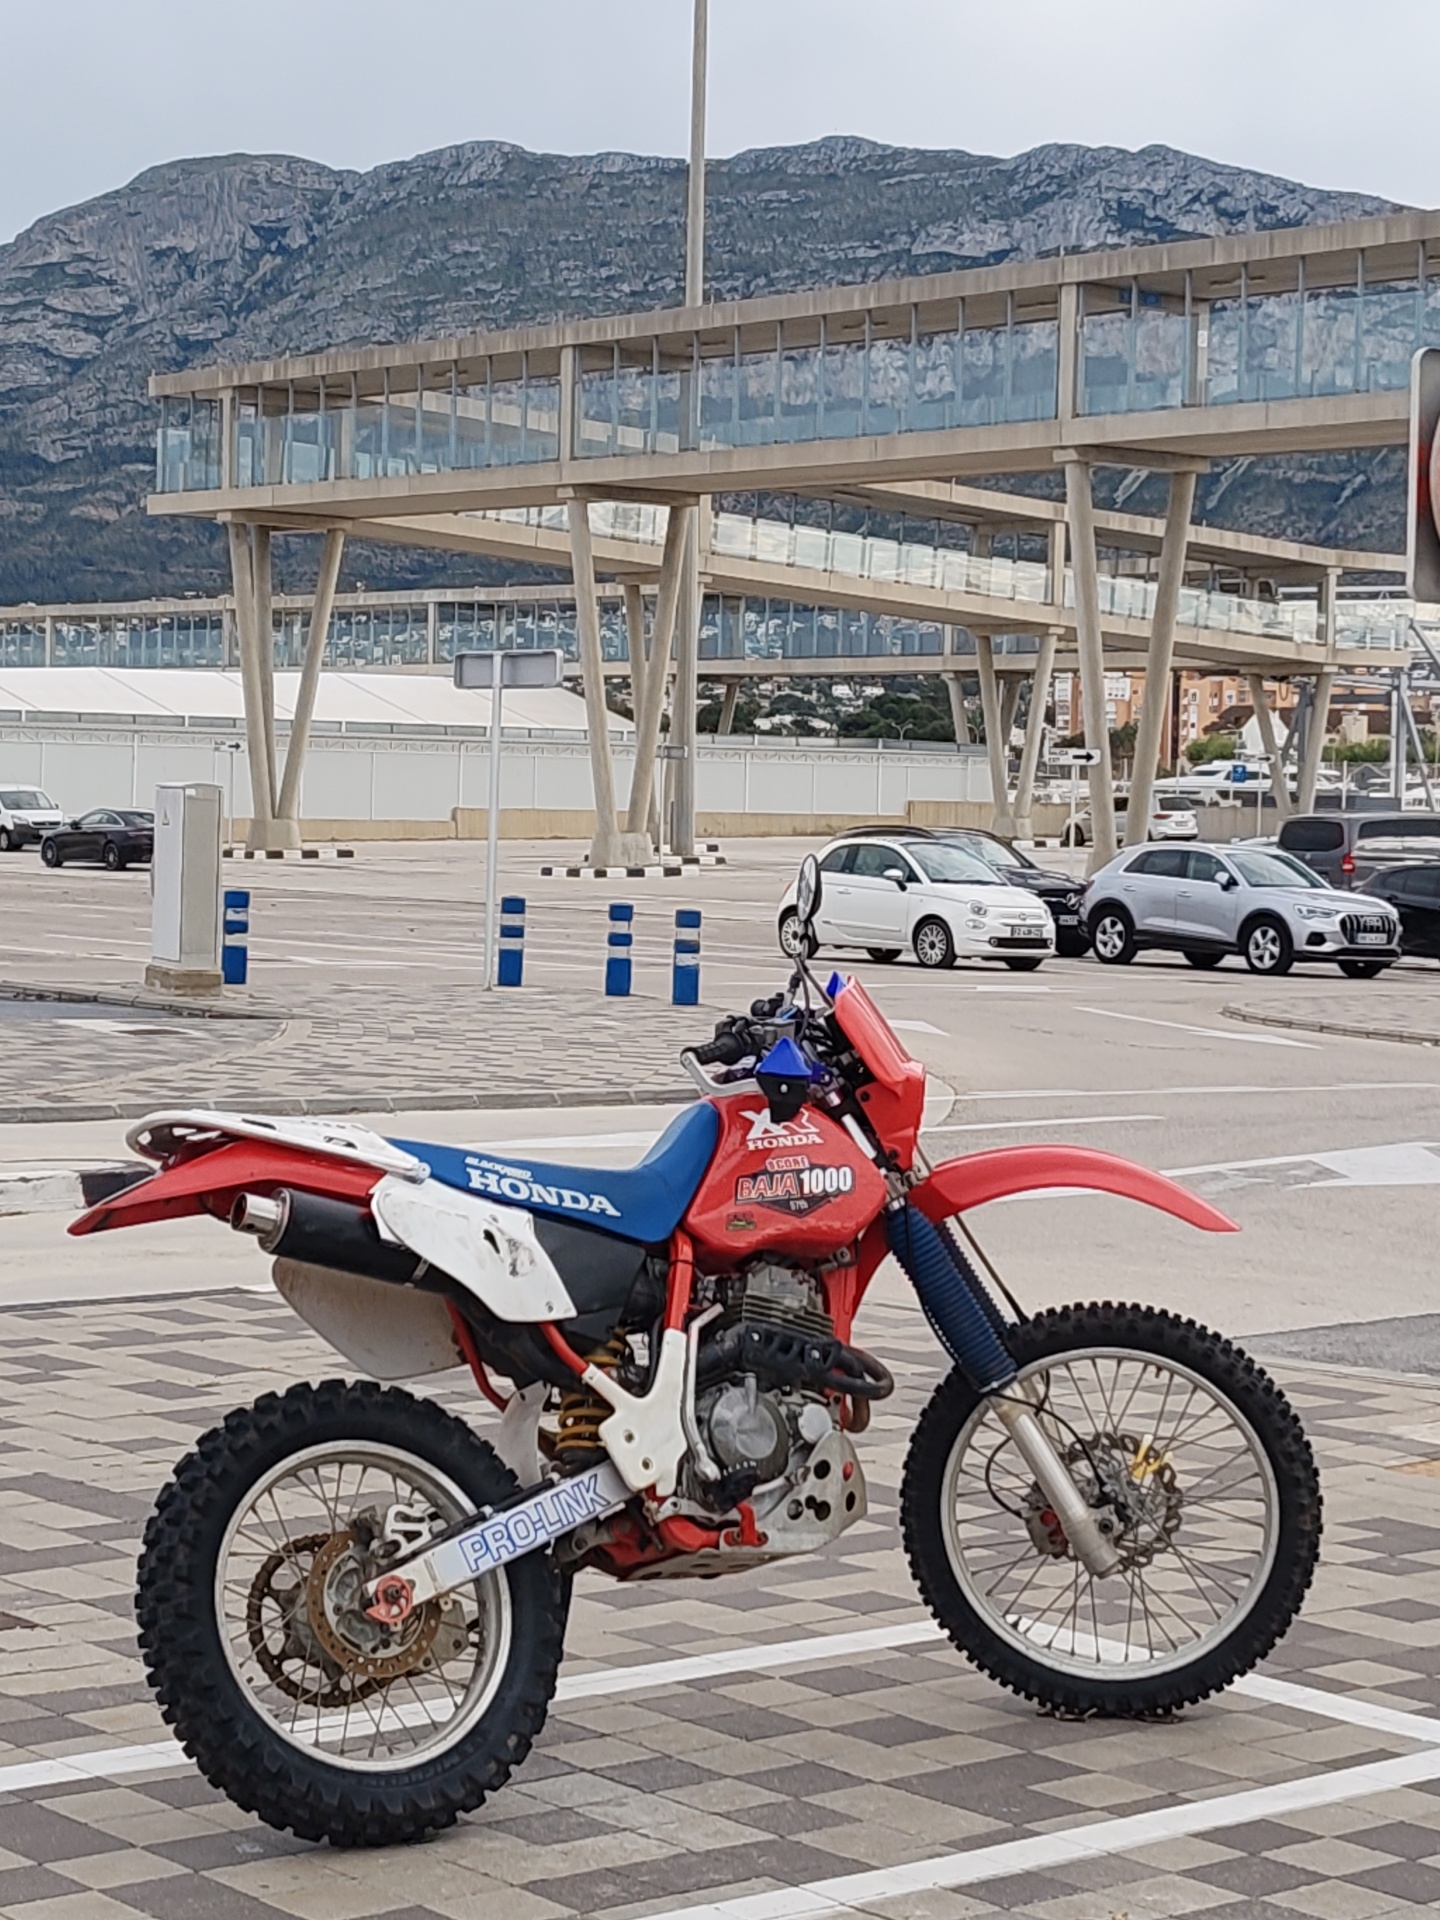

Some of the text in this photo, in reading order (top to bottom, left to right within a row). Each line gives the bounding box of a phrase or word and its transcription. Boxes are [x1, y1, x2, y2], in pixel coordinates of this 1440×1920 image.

[746, 1134, 825, 1151] HONDA
[466, 1167, 622, 1217] HONDA
[737, 1166, 852, 1200] BAJA 1000
[458, 1473, 612, 1574] PRO-LINK
